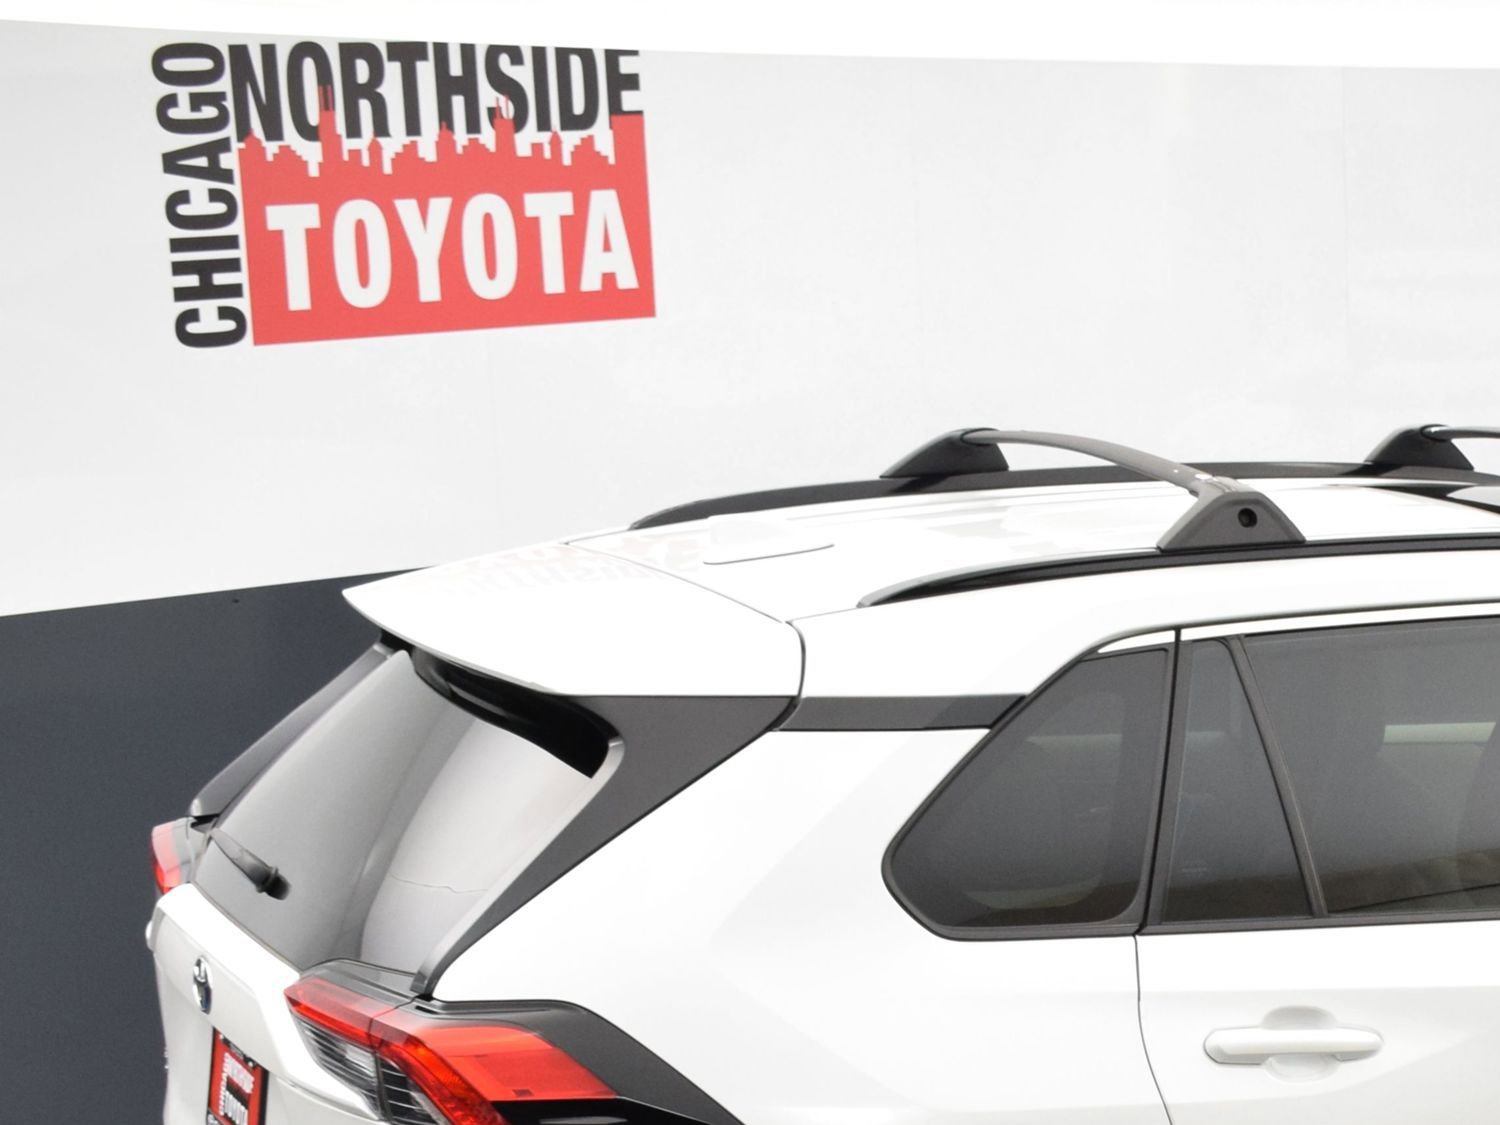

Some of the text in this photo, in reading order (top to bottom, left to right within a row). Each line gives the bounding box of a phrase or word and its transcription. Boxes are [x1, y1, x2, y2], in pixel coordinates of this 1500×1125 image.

[227, 41, 645, 143] NORTHSIDE
[150, 42, 247, 348] CHICAGO
[265, 188, 639, 311] TOYOTA
